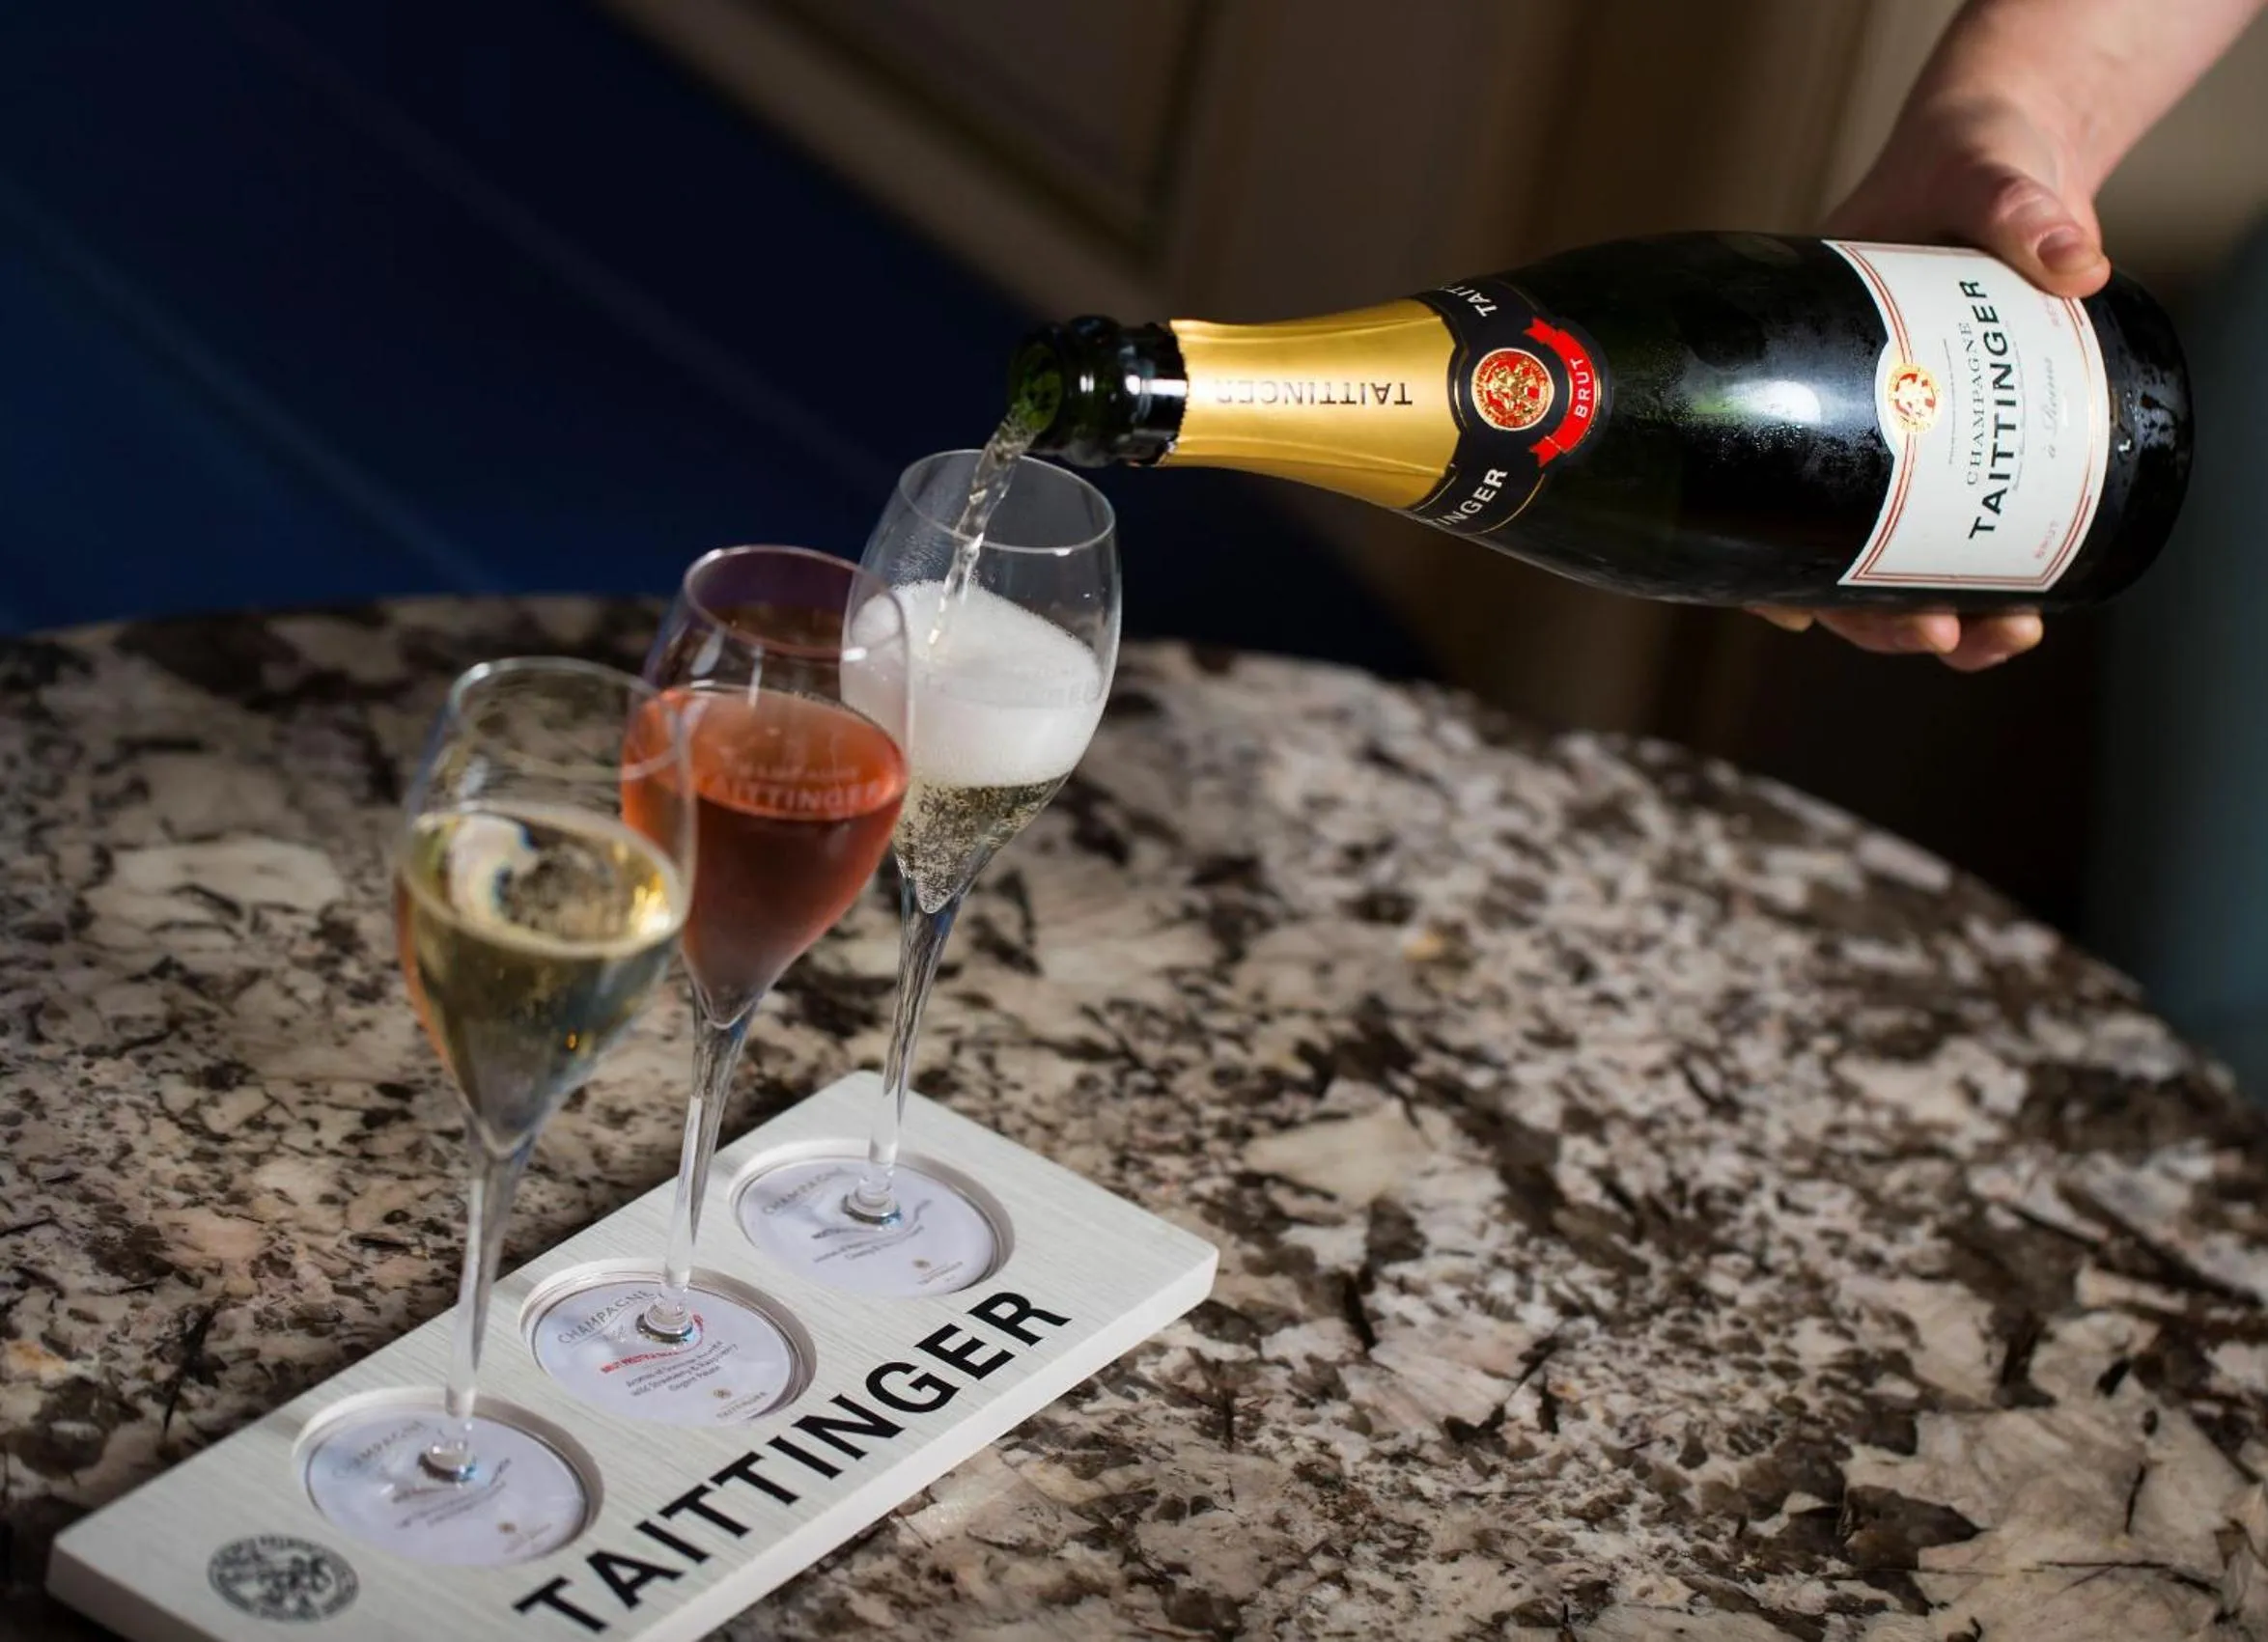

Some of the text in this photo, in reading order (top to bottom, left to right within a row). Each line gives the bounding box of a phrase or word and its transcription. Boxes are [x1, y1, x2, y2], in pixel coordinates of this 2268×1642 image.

[1214, 378, 1414, 405] TAITTINGER
[1570, 358, 1591, 418] BRUT
[1959, 320, 1985, 487] CHAMPAGNE
[1959, 278, 2017, 541] TAITTINGER
[513, 1292, 1072, 1633] TAITTINGER
